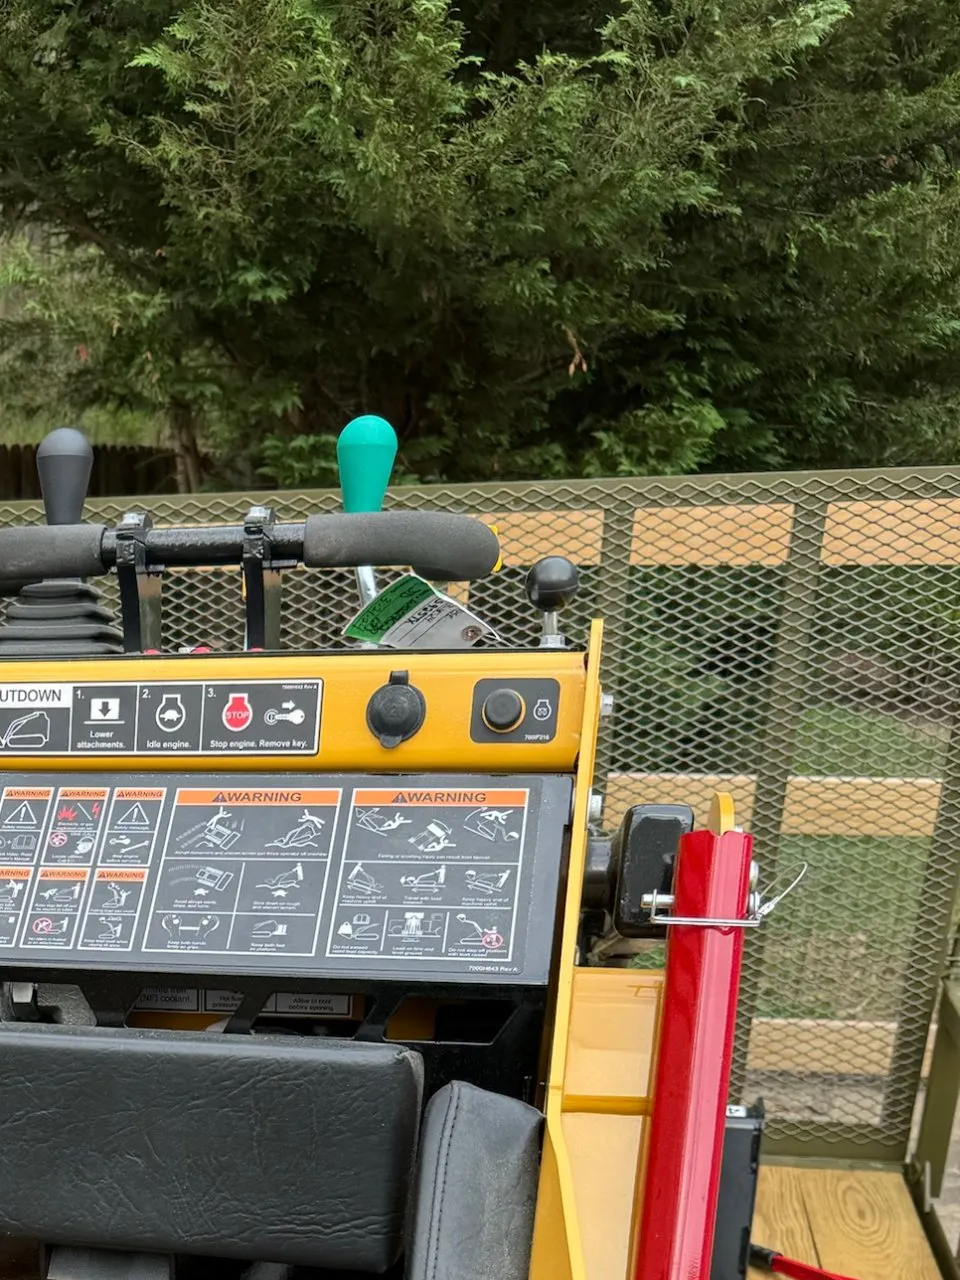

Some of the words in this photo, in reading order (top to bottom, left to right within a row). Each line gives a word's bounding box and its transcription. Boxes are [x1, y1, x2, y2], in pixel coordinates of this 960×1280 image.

[76, 690, 84, 699] 1.
[142, 689, 151, 698] 2.
[208, 688, 216, 698] 3.
[226, 710, 250, 720] STOP
[90, 730, 114, 738] Lower
[76, 739, 126, 749] attachments.
[146, 740, 161, 748] Idle
[163, 741, 192, 750] engine.
[210, 740, 228, 749] Stop
[229, 740, 257, 749] engine.
[258, 739, 290, 748] Remove
[292, 739, 307, 748] key.
[228, 792, 302, 802] WARNING
[408, 792, 486, 803] WARNING
